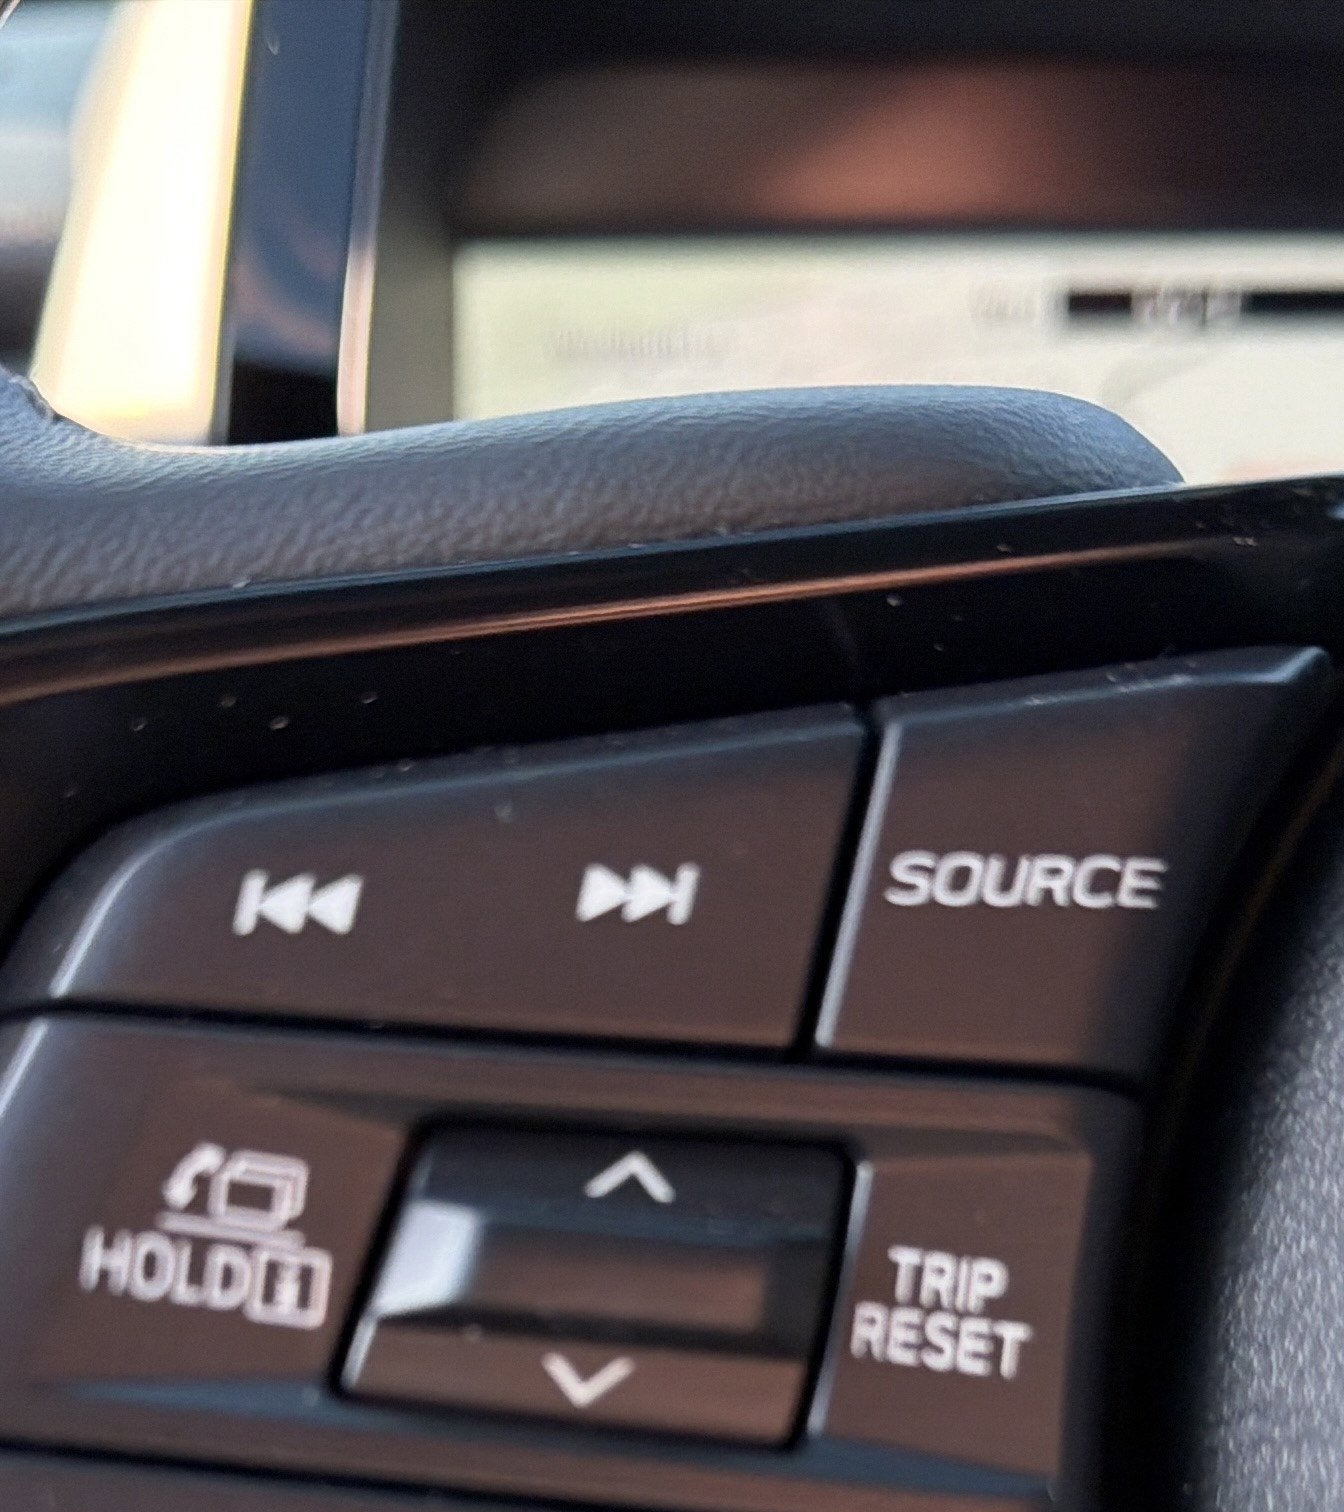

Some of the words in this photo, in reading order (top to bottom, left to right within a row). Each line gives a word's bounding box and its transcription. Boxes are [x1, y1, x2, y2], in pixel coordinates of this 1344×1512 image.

[886, 849, 1165, 910] SOURCE
[78, 1224, 253, 1312] HOLD
[887, 1245, 1010, 1314] TRIP
[850, 1301, 1034, 1380] RESET
